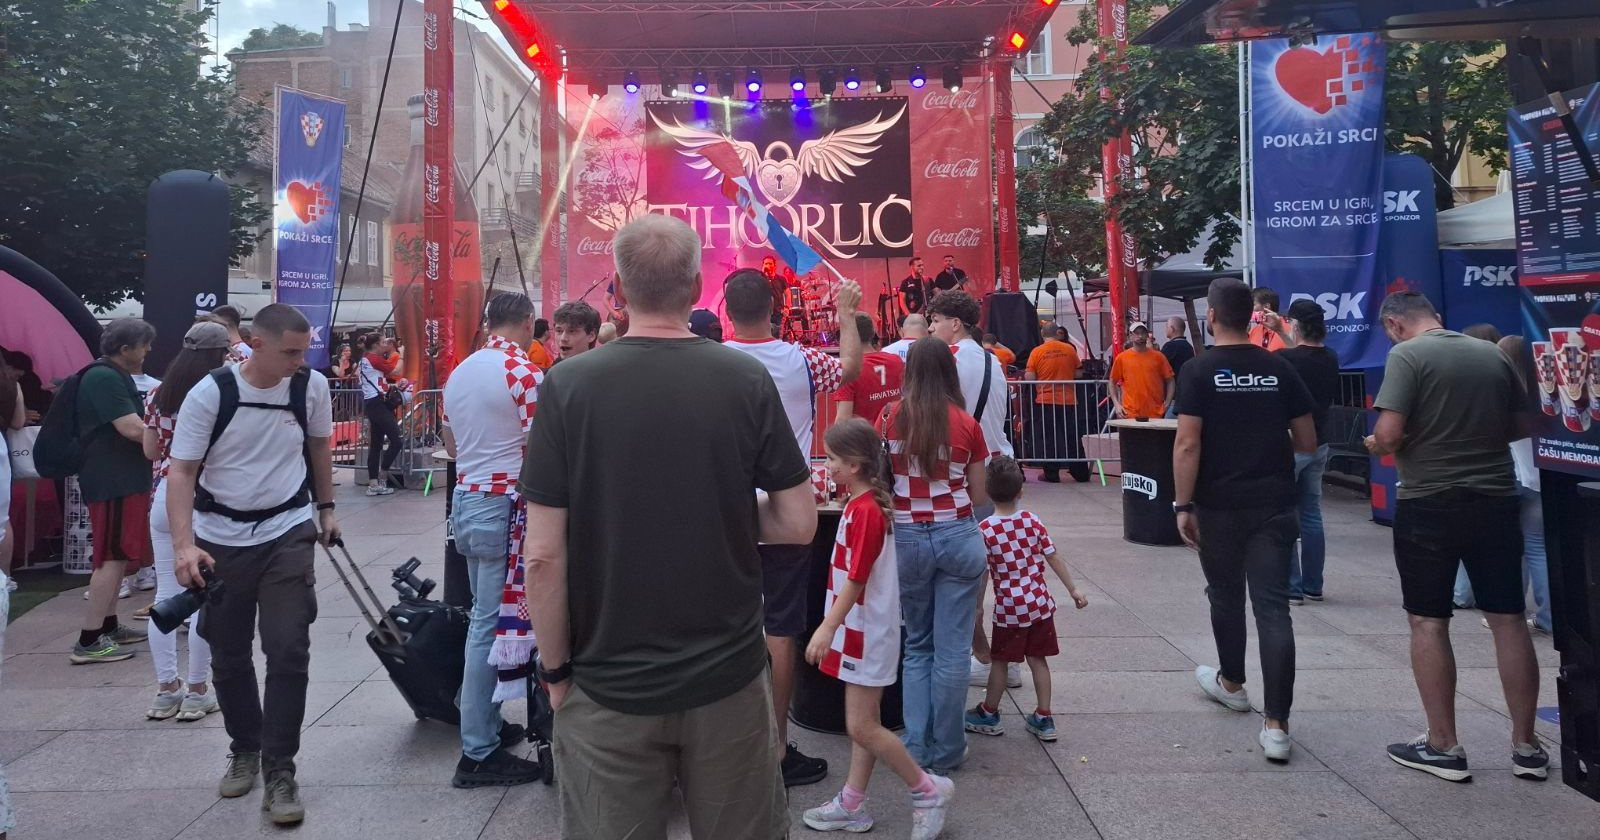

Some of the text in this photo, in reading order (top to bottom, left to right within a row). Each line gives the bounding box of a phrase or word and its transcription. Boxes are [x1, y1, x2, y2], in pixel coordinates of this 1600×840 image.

[922, 90, 980, 110] Coca-Cola
[1262, 127, 1332, 149] POKAŽI
[925, 158, 980, 179] Coca-Cola
[1273, 197, 1374, 212] SRCEM U IGRI,
[1383, 190, 1421, 213] SK
[1266, 215, 1316, 228] IGROM
[1320, 215, 1342, 227] ZA
[1384, 214, 1421, 222] SPONZOR
[280, 229, 333, 244] POKAŽI SRCE
[926, 227, 982, 248] Coca-Cola
[281, 270, 304, 279] SRCEM
[304, 272, 310, 280] U
[1463, 265, 1518, 287] PSK
[278, 280, 300, 288] IGROM
[300, 281, 311, 289] ZA
[873, 364, 886, 386] 7
[1213, 373, 1279, 387] Eldra
[869, 388, 900, 401] HRVATSKA
[1538, 445, 1560, 459] ČAŠU
